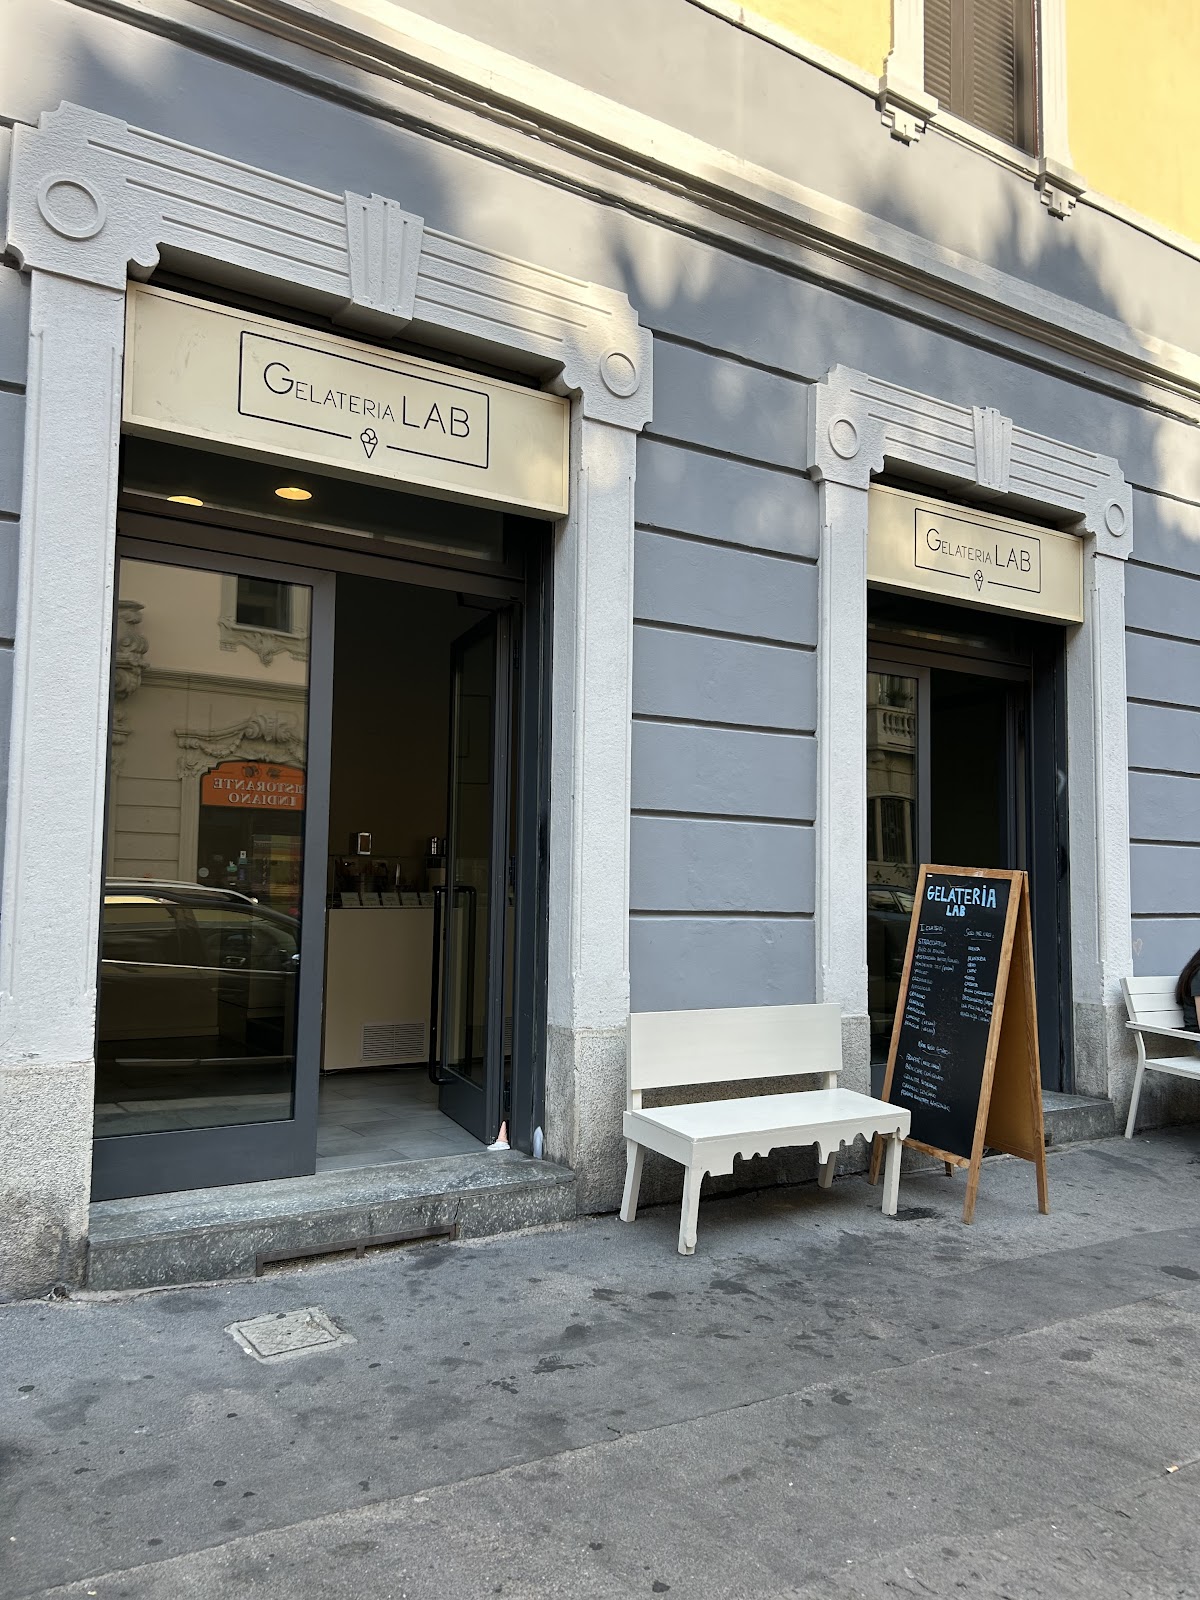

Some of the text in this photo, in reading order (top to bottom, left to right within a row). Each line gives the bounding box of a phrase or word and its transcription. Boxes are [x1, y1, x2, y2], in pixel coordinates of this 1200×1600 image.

[402, 395, 470, 438] LAB
[995, 544, 1031, 572] LAB
[945, 904, 966, 917] LAB
